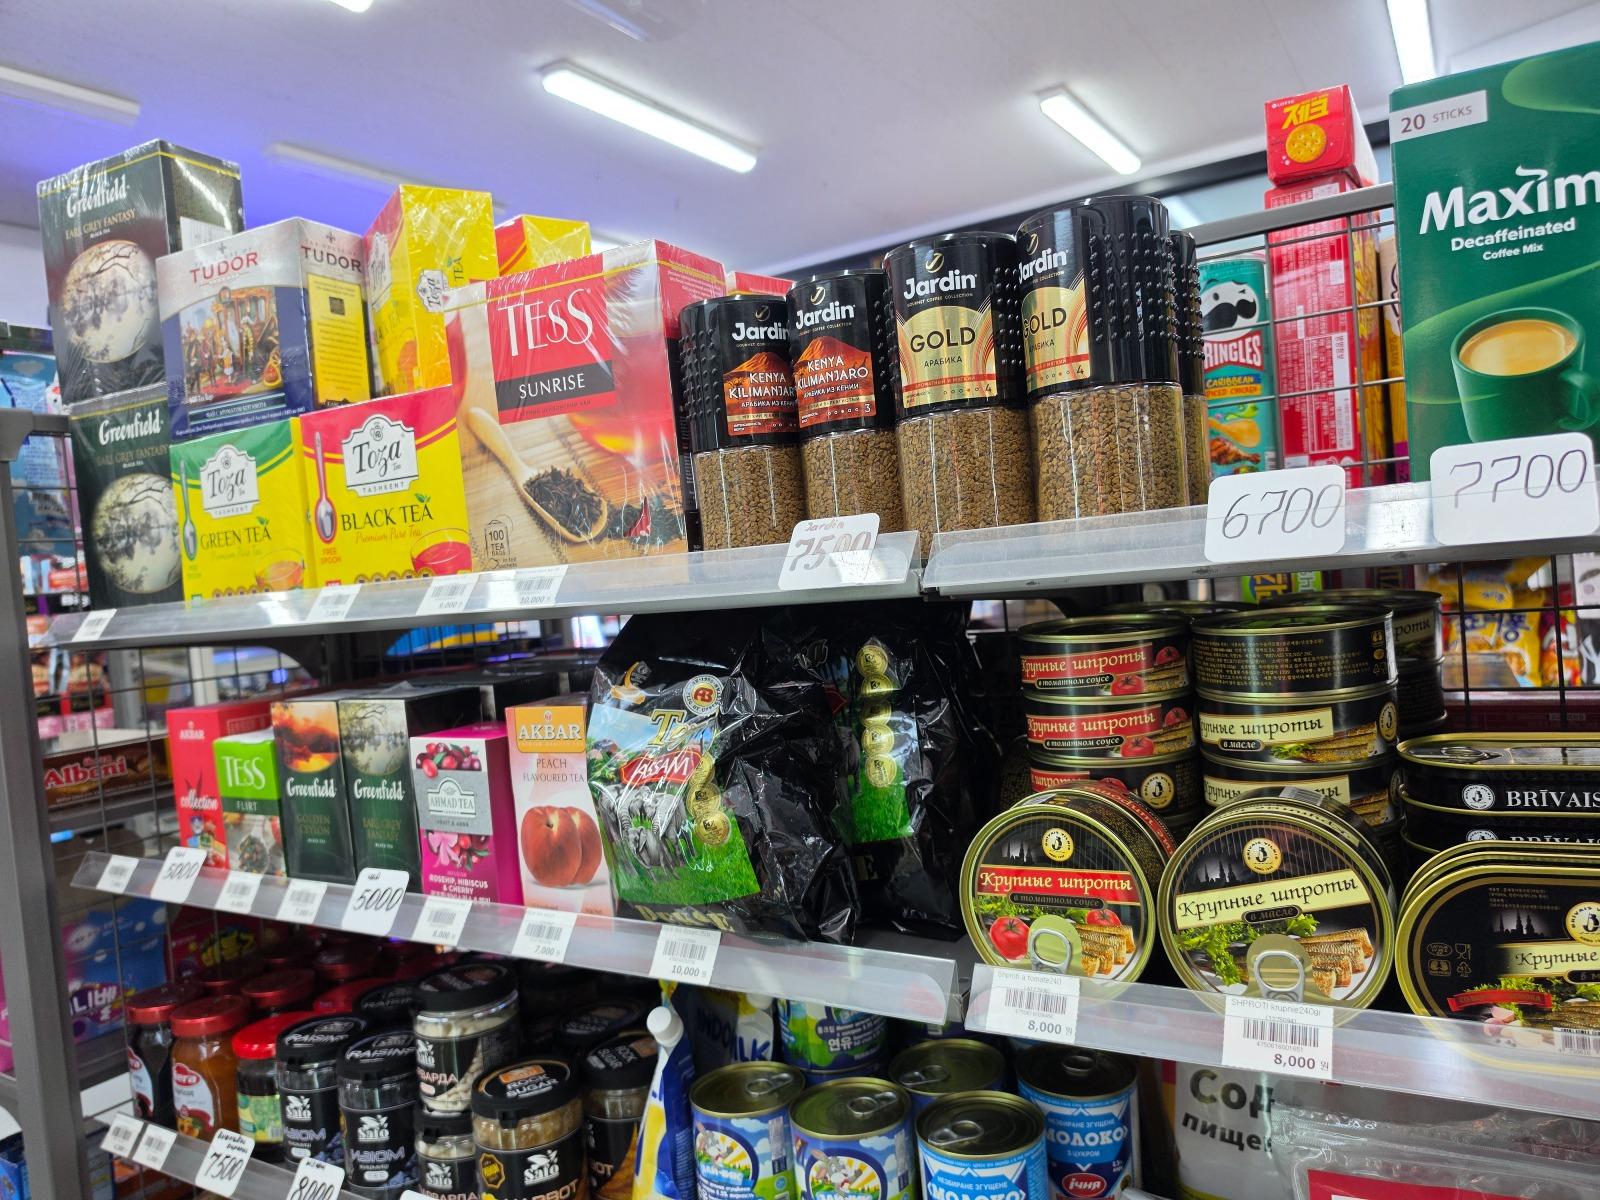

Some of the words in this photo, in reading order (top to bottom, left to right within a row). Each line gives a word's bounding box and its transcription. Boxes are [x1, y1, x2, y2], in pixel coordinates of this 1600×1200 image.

[1281, 94, 1329, 130] 제크
[1401, 113, 1426, 134] 20
[1432, 105, 1473, 123] STICKS
[67, 174, 127, 218] Greenfield
[1419, 165, 1600, 235] Maxim
[103, 208, 136, 227] FANTASY
[1451, 217, 1576, 252] Decaffeinated
[303, 246, 362, 273] TUDOR
[1482, 248, 1521, 261] Coffee
[1522, 242, 1544, 254] Mix
[190, 251, 258, 283] TUDOR
[453, 256, 465, 281] TEA
[903, 269, 977, 301] Jardin
[498, 287, 594, 357] TESS
[795, 302, 856, 330] Jardin
[1022, 307, 1067, 339] GOLD
[910, 326, 976, 353] GOLD
[924, 355, 963, 368] АРАБИКА
[1205, 333, 1263, 370] RINGLES
[807, 355, 845, 372] KENYA
[1076, 364, 1085, 375] 4
[519, 372, 586, 400] SUNRISE
[749, 372, 787, 384] KENYA
[797, 367, 869, 390] KILIMANJARO
[985, 383, 992, 393] 4
[1205, 376, 1255, 389] CARIBBEAN
[826, 386, 835, 395] ИЗ
[836, 383, 860, 393] КЕНИИ
[1206, 387, 1228, 398] PICED
[1229, 385, 1259, 396] CHICKEN
[741, 400, 771, 409] АРАБИКА
[864, 403, 871, 414] 3
[99, 408, 162, 446] Greenfield
[353, 439, 402, 478] Toza
[208, 465, 247, 500] Toza
[362, 481, 405, 494] TASHKENT
[1449, 449, 1588, 509] 7700
[342, 507, 396, 531] BLACK
[400, 503, 434, 523] TEA
[1222, 484, 1343, 539] 6700
[200, 528, 241, 550] GREEN
[247, 526, 272, 544] TEA
[488, 530, 505, 541] 100
[491, 541, 505, 550] TEA
[789, 531, 872, 572] 7500
[1022, 656, 1067, 678] Крупные
[1072, 651, 1147, 673] шпроты
[1043, 677, 1085, 687] томатном
[1086, 674, 1110, 684] соусе
[519, 724, 582, 742] AKBAR
[1082, 711, 1156, 735] шпроты
[1240, 716, 1324, 742] шпроты
[1051, 738, 1095, 748] томатном
[1096, 736, 1120, 746] соусе
[1229, 740, 1257, 749] масле
[221, 755, 266, 790] TESS
[536, 758, 568, 769] PEACH
[287, 777, 336, 798] Greenfield
[522, 773, 568, 783] FLAVOURED
[570, 773, 586, 782] TEA
[354, 778, 403, 800] Greenfield
[1506, 789, 1600, 808] BRĪVAIS
[181, 789, 218, 811] collection
[236, 800, 258, 812] FLIRT
[431, 796, 458, 809] AHMAD
[460, 797, 474, 810] TEA
[163, 861, 199, 881] 5000
[429, 874, 457, 885] ROSEHIP,
[458, 876, 489, 889] HIBISCUS
[443, 884, 447, 892] &
[448, 884, 474, 896] CHERRY
[979, 871, 1052, 892] Крупные
[1057, 876, 1133, 895] шпроты
[353, 887, 405, 913] 5000
[1020, 894, 1073, 906] томатном
[1074, 898, 1100, 907] соусе
[1178, 893, 1264, 921] Крупные
[1270, 876, 1359, 903] шпроты
[1250, 913, 1257, 921] в
[1258, 906, 1295, 921] масле
[671, 965, 701, 977] 10,000
[1514, 951, 1598, 971] Крупные
[1231, 999, 1269, 1010] SHPROTI
[1028, 1019, 1062, 1035] 8,000
[1273, 1053, 1316, 1070] 8,000
[505, 1078, 559, 1098] SUGAR
[506, 1074, 549, 1091] ROCK
[1189, 1069, 1276, 1118] Сод
[357, 1126, 390, 1141] Safo
[1086, 1118, 1116, 1129] ЗГУЩЕНЕ
[1072, 1149, 1100, 1158] ЦУКРОМ
[204, 1151, 244, 1182] 7500
[524, 1162, 560, 1184] Safo
[975, 1180, 1008, 1191] ЗГУЩЕНЕ
[1069, 1178, 1102, 1190] ічня
